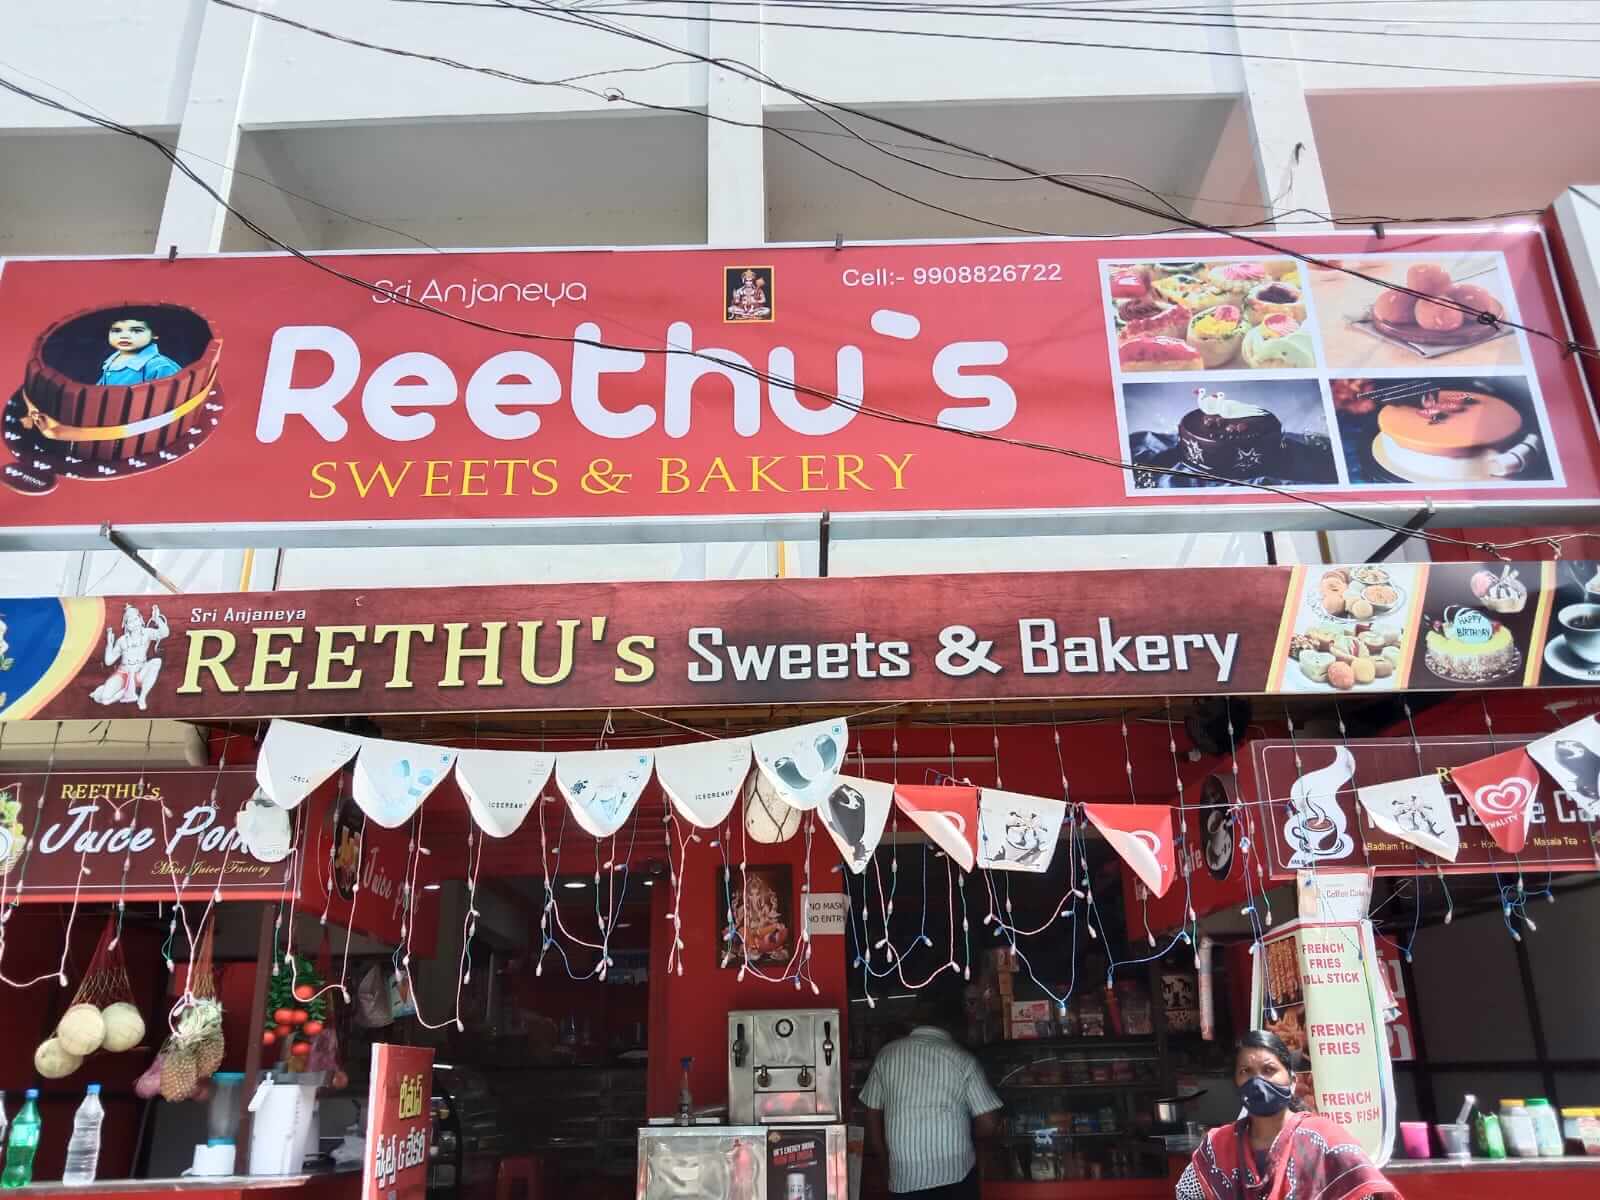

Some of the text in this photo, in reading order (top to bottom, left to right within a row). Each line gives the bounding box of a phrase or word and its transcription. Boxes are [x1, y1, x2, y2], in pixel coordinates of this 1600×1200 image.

[841, 263, 1063, 287] Cell:- 9908826722
[372, 277, 588, 309] Sri Anjaneya
[308, 452, 918, 500] SWEETS & BAKERY
[190, 607, 306, 624] Sri Anjaneya
[176, 615, 1240, 694] REETHU's Sweets & Bakery
[61, 783, 162, 801] REETHU's
[40, 804, 156, 854] Juice
[1302, 943, 1345, 954] FRENCH
[1309, 958, 1342, 969] FRIES
[1326, 972, 1360, 985] STICK
[1311, 1023, 1366, 1037] FRENCH
[1319, 1041, 1361, 1056] FRIES
[1322, 1091, 1372, 1106] FRENCH
[1356, 1106, 1380, 1122] FISH
